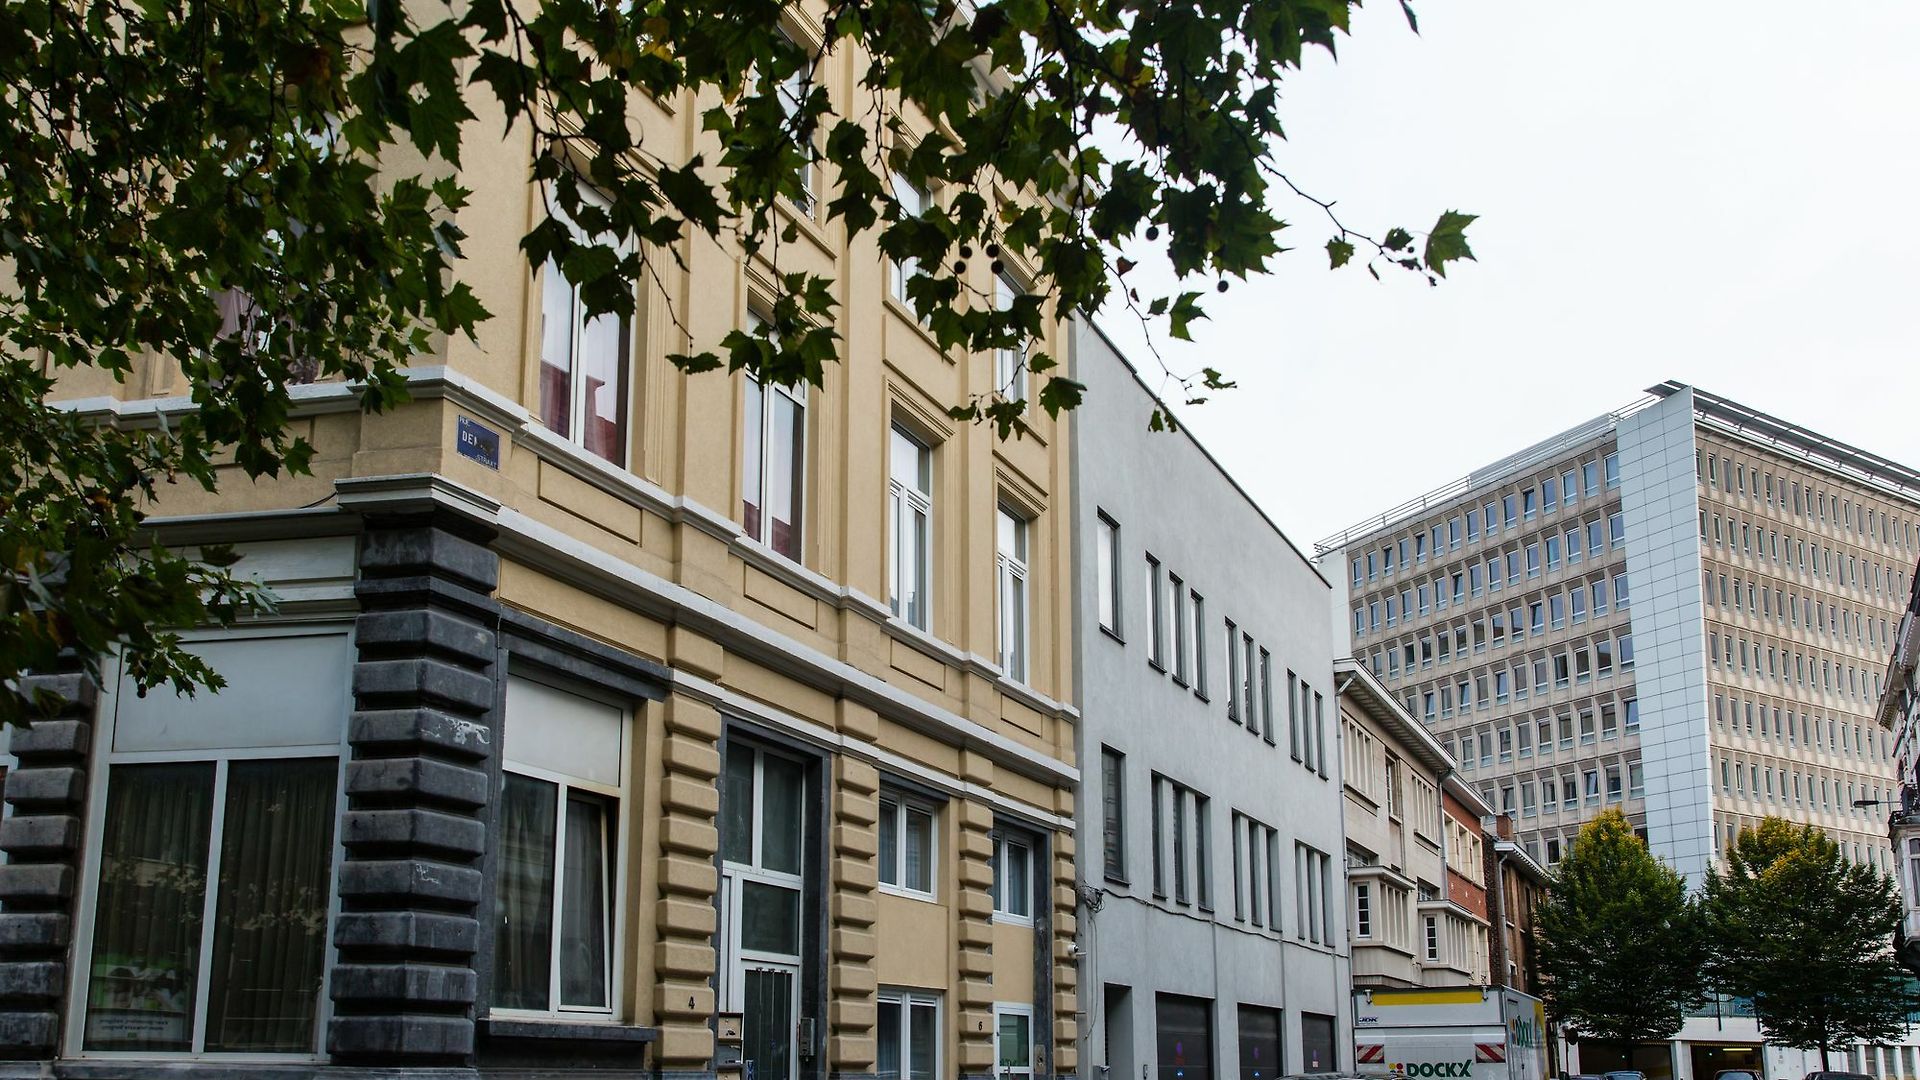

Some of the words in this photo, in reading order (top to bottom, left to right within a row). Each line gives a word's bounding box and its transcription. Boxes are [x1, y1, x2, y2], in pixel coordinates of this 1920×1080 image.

[688, 996, 695, 1009] 4
[978, 1021, 983, 1031] 6
[1406, 1059, 1472, 1077] DOCKX
